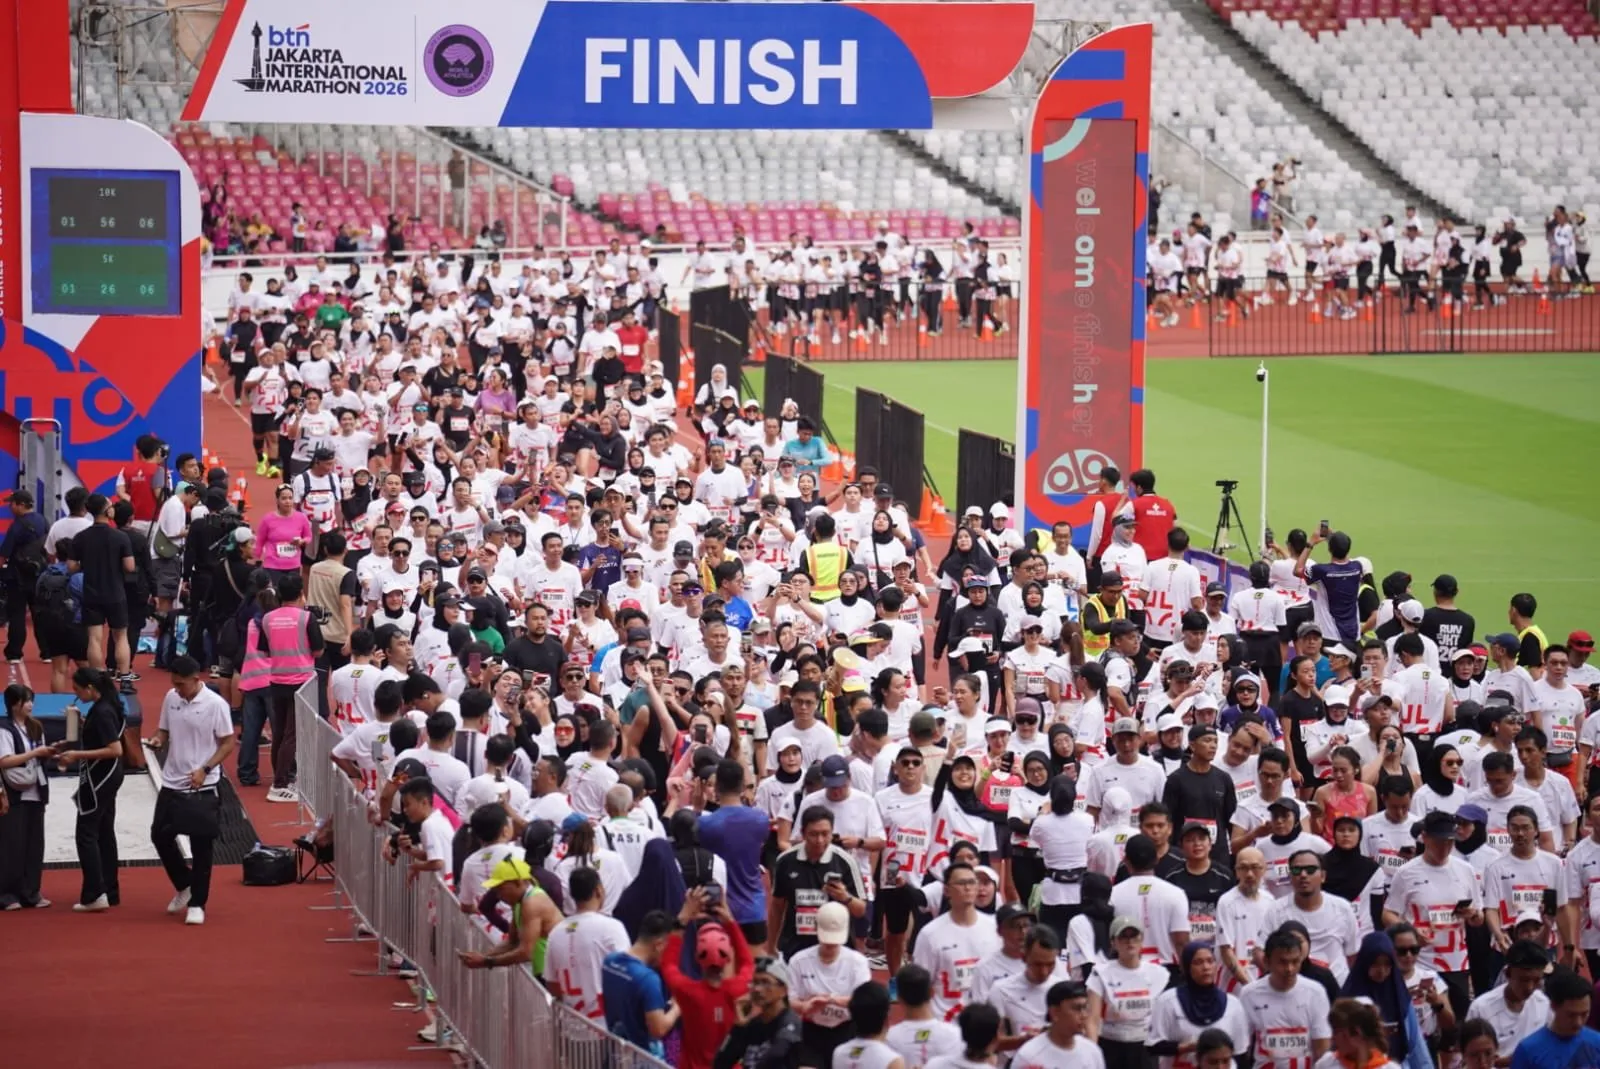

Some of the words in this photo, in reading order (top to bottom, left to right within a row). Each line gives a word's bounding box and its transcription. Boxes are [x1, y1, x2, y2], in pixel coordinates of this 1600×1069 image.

[265, 48, 344, 64] JAKARTA
[265, 63, 407, 81] INTERNATIONAL
[585, 38, 858, 106] FINISH
[266, 79, 361, 94] MARATHON
[364, 81, 408, 96] 2026
[99, 187, 116, 197] 10K
[60, 216, 76, 228] 01
[100, 217, 116, 228] 56
[139, 218, 155, 229] 06
[1074, 158, 1101, 308] welcome
[102, 254, 114, 263] 5K
[61, 283, 76, 294] 01
[100, 284, 116, 295] 26
[139, 285, 155, 295] 06
[1072, 312, 1101, 438] finisher
[1439, 624, 1463, 634] RUN
[1488, 835, 1495, 845] M
[1379, 856, 1386, 865] M
[1514, 892, 1521, 901] M
[1269, 1037, 1276, 1047] M
